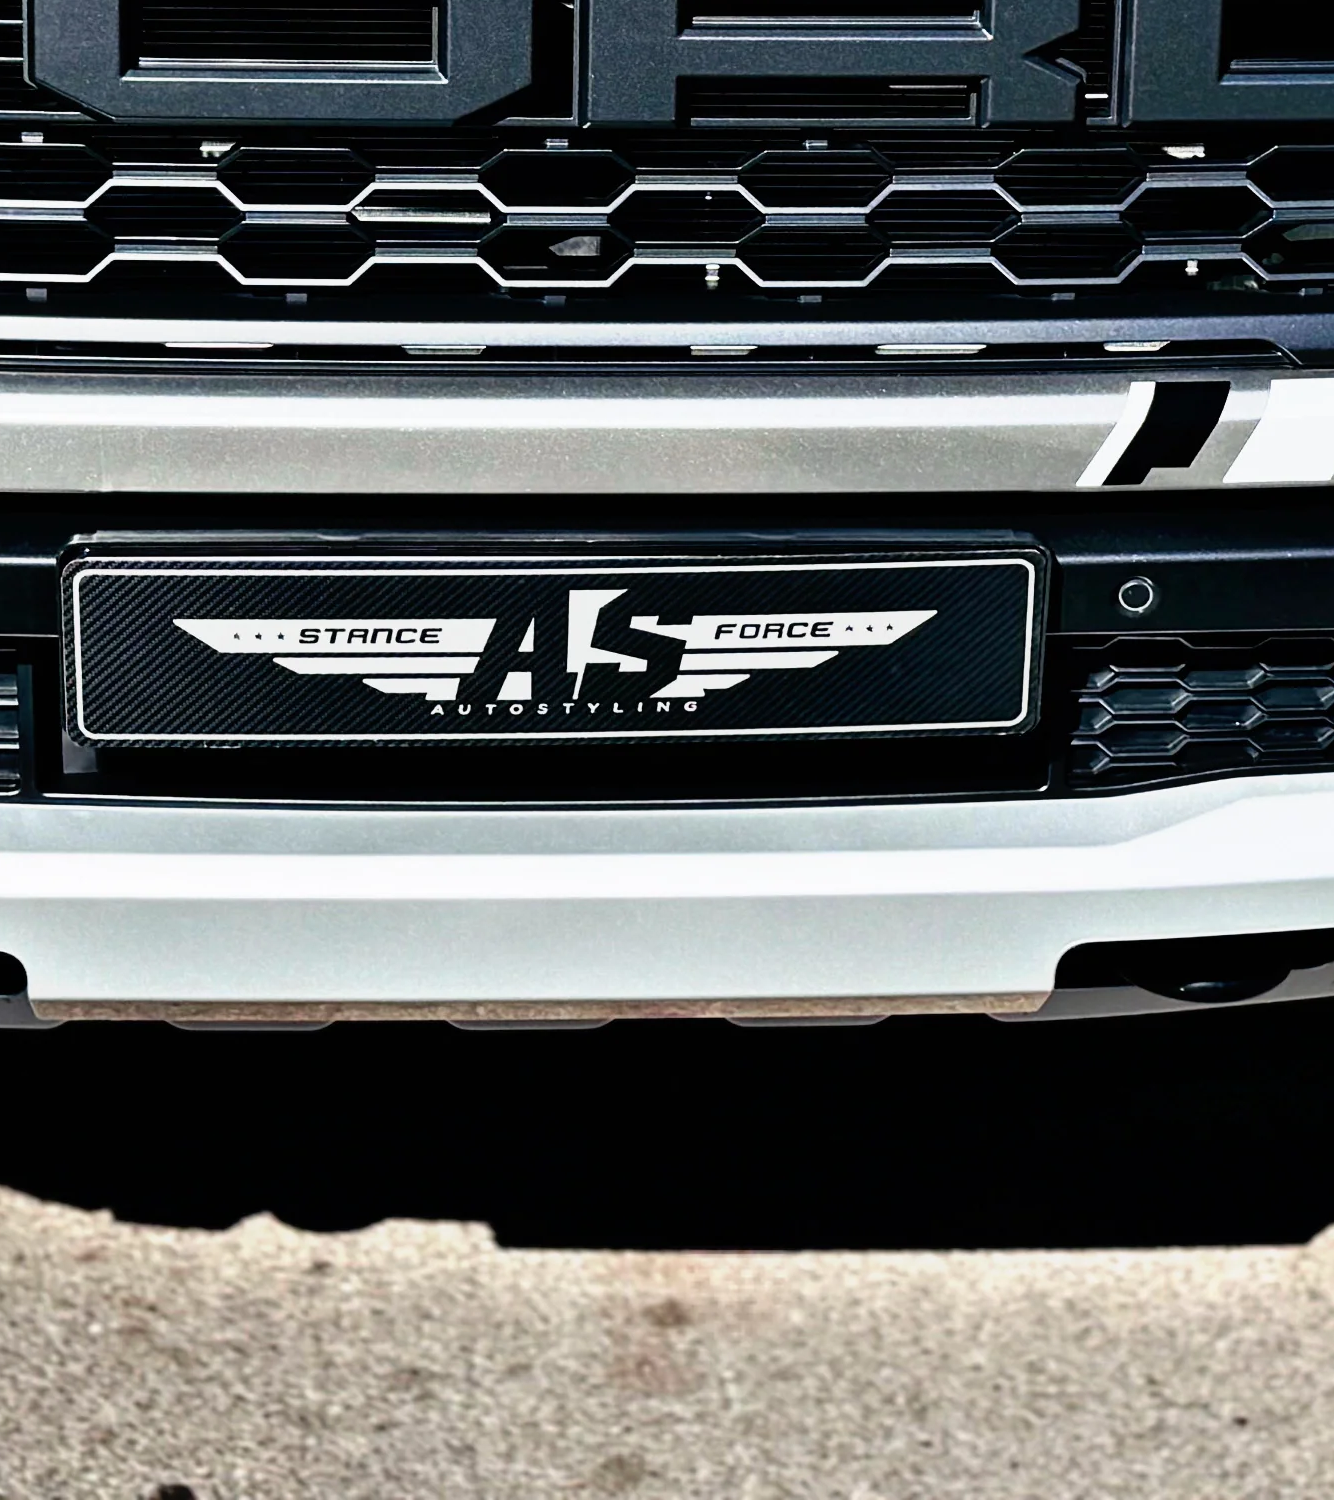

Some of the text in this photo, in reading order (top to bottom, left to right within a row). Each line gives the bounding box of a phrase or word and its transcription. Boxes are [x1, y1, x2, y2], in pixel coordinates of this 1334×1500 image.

[297, 627, 444, 645] STANCE
[713, 620, 835, 641] FORCE
[429, 700, 699, 716] AUTOSTYLING
